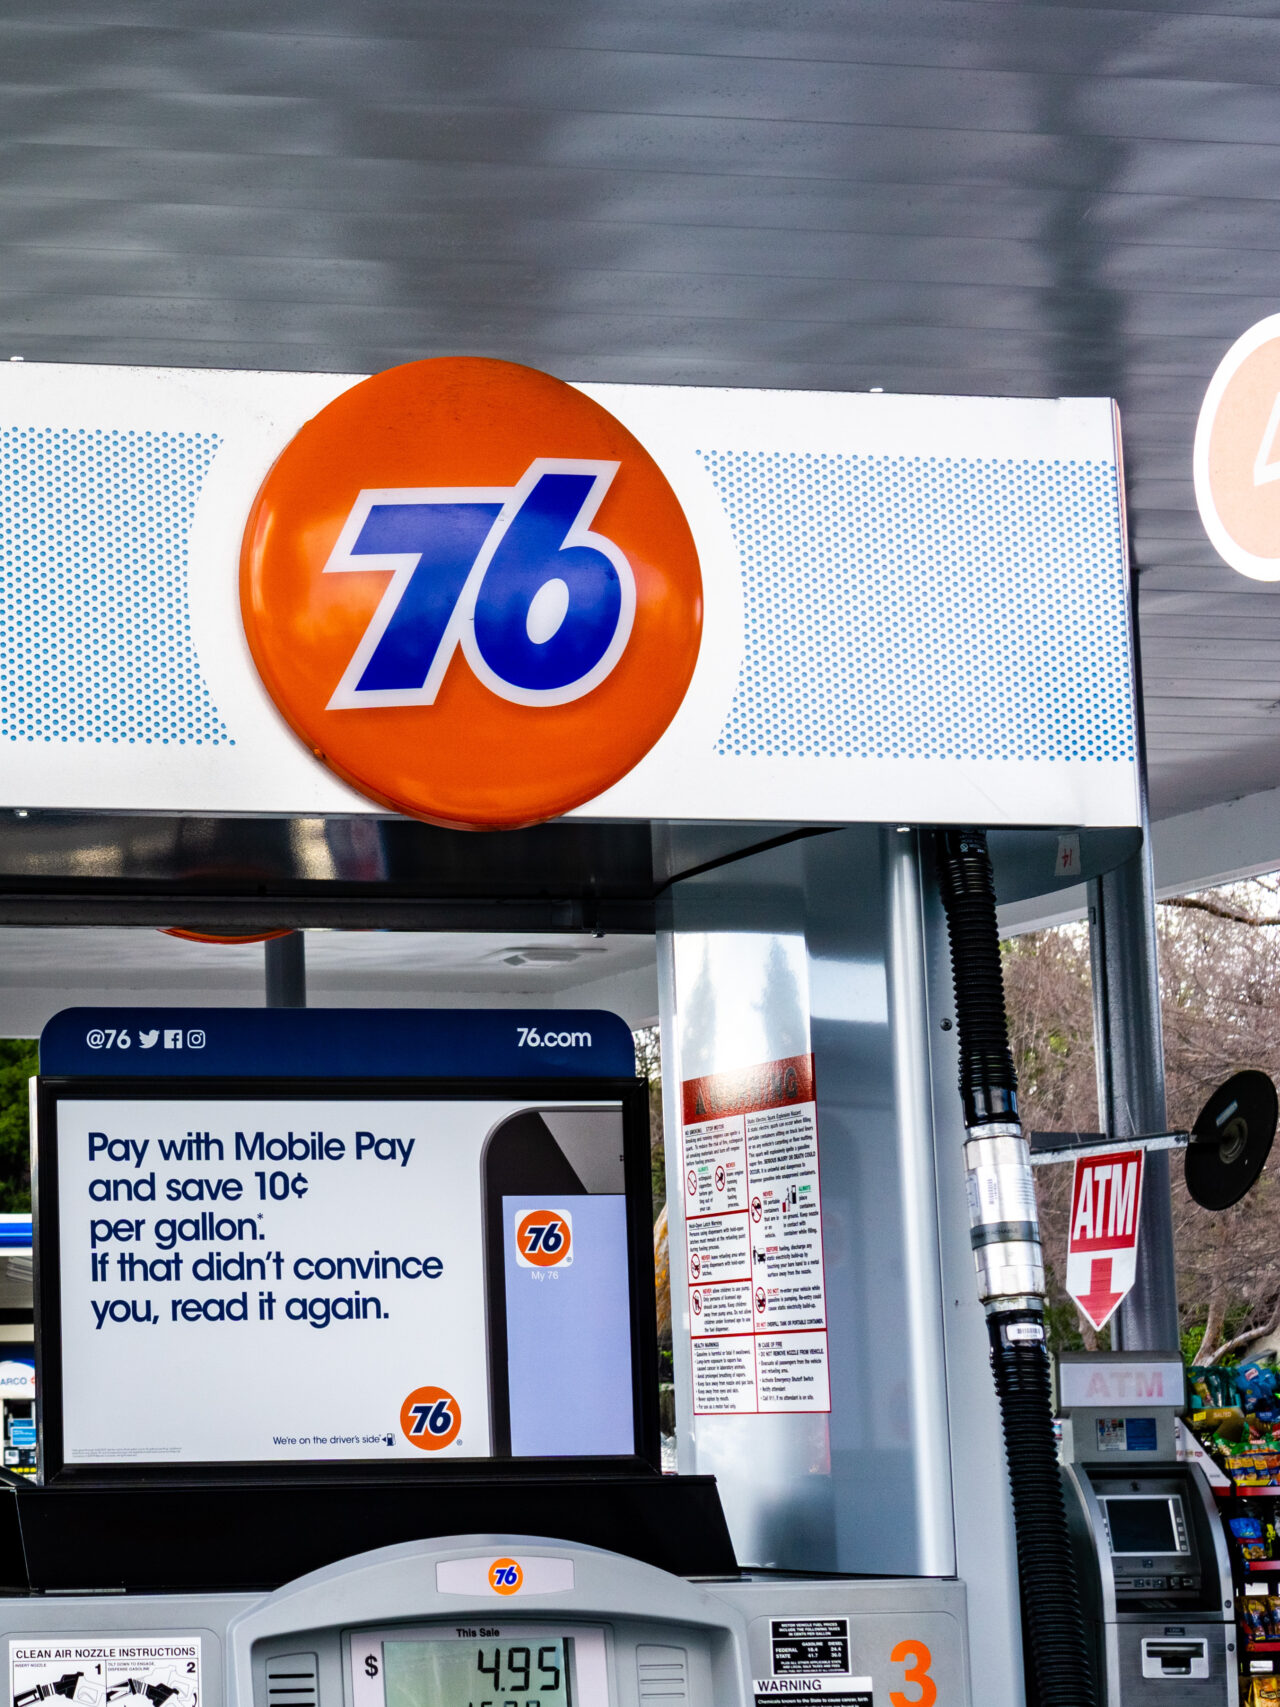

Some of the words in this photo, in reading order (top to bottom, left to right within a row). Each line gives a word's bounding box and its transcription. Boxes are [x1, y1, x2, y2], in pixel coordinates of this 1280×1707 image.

[322, 457, 636, 710] 76
[86, 1028, 131, 1050] @76
[516, 1027, 592, 1048] 76.com
[88, 1131, 150, 1169] Pay
[157, 1131, 224, 1161] with
[234, 1131, 346, 1161] Mobile
[355, 1131, 416, 1168] Pay
[88, 1171, 156, 1202] and
[166, 1178, 244, 1202] save
[254, 1171, 309, 1203] 10¢
[1073, 1162, 1137, 1240] ATM
[90, 1218, 146, 1249] per
[524, 1221, 564, 1254] 76
[91, 1251, 110, 1282] If
[116, 1251, 184, 1282] that
[191, 1251, 285, 1282] didn't
[293, 1250, 444, 1281] convince
[531, 1271, 545, 1282] My
[547, 1271, 559, 1280] 76
[90, 1299, 160, 1330] you,
[171, 1291, 248, 1322] read
[258, 1291, 277, 1321] it
[284, 1290, 390, 1329] again.
[0, 1377, 27, 1385] ARCO
[1086, 1371, 1163, 1398] ATM
[408, 1399, 455, 1436] 76
[273, 1436, 297, 1445] We're
[313, 1436, 327, 1445] the
[330, 1435, 360, 1445] driver's
[493, 1565, 518, 1586] 76
[456, 1628, 476, 1637] This
[480, 1628, 500, 1637] Sale
[16, 1649, 52, 1659] CLEAN
[55, 1649, 71, 1658] AIR
[76, 1648, 116, 1658] NOZZLE
[120, 1647, 196, 1657] INSTRUCTIONS
[95, 1664, 101, 1674] 1
[186, 1662, 196, 1673] 2
[365, 1654, 379, 1679] $
[478, 1647, 560, 1692] 4.95
[889, 1640, 937, 1707] 3
[758, 1679, 822, 1692] WARNING
